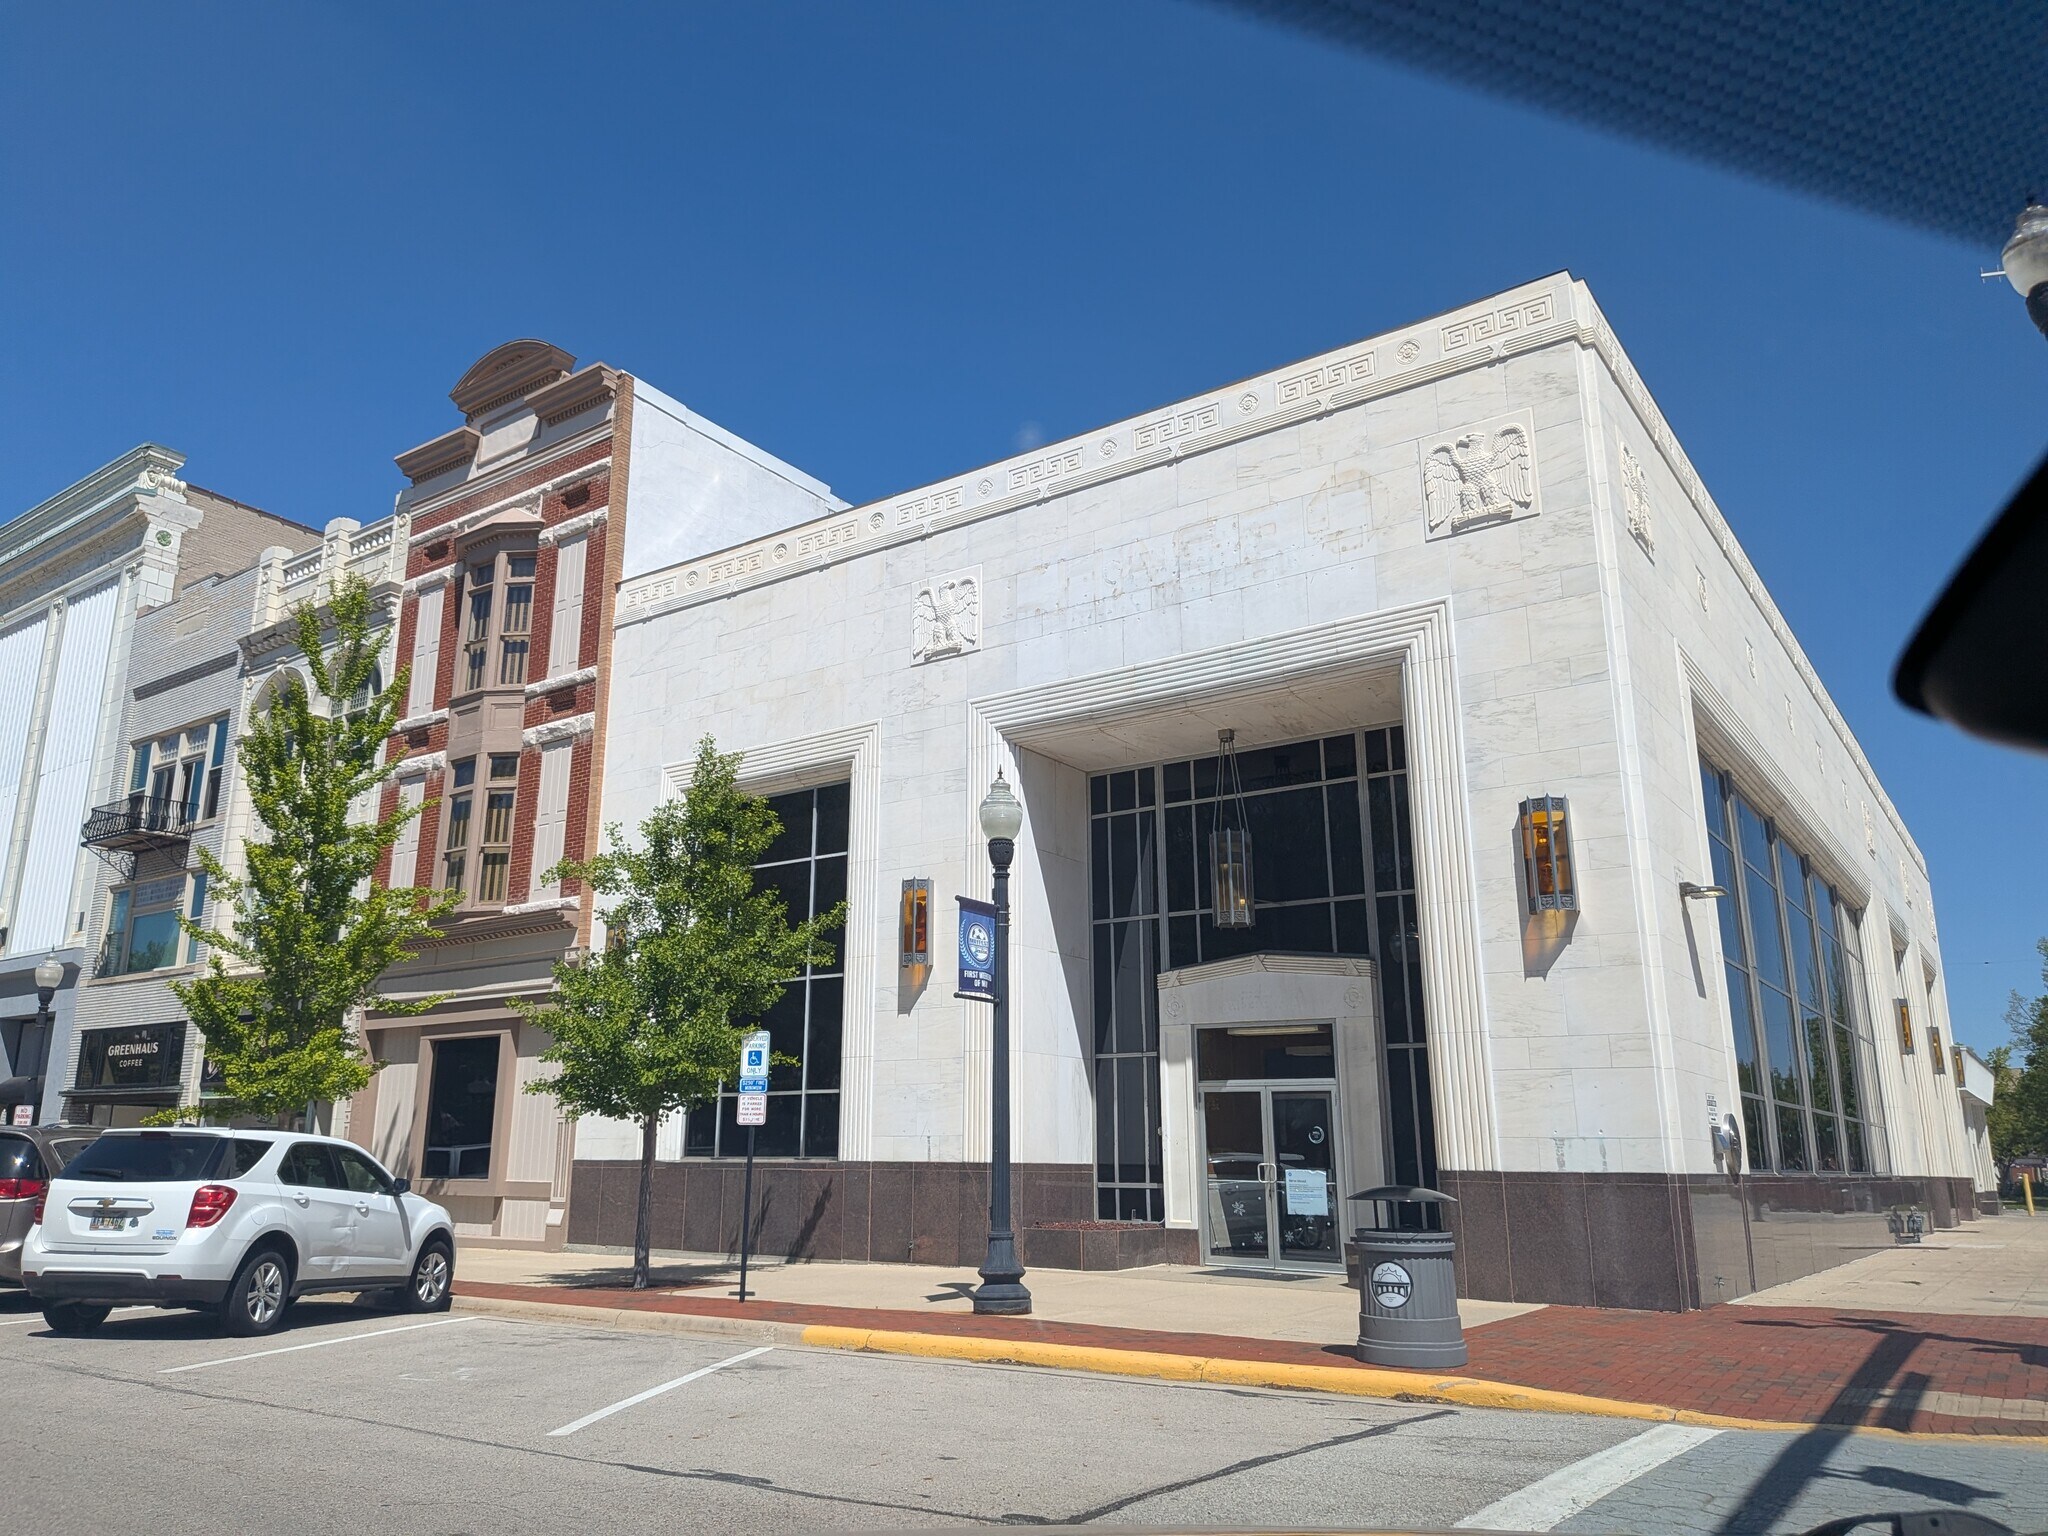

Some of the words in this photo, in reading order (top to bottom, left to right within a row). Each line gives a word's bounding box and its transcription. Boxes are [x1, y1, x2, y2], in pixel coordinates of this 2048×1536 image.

[964, 970, 978, 978] FIRST
[108, 1042, 158, 1057] GREENHAUS
[119, 1059, 143, 1068] COFFEE
